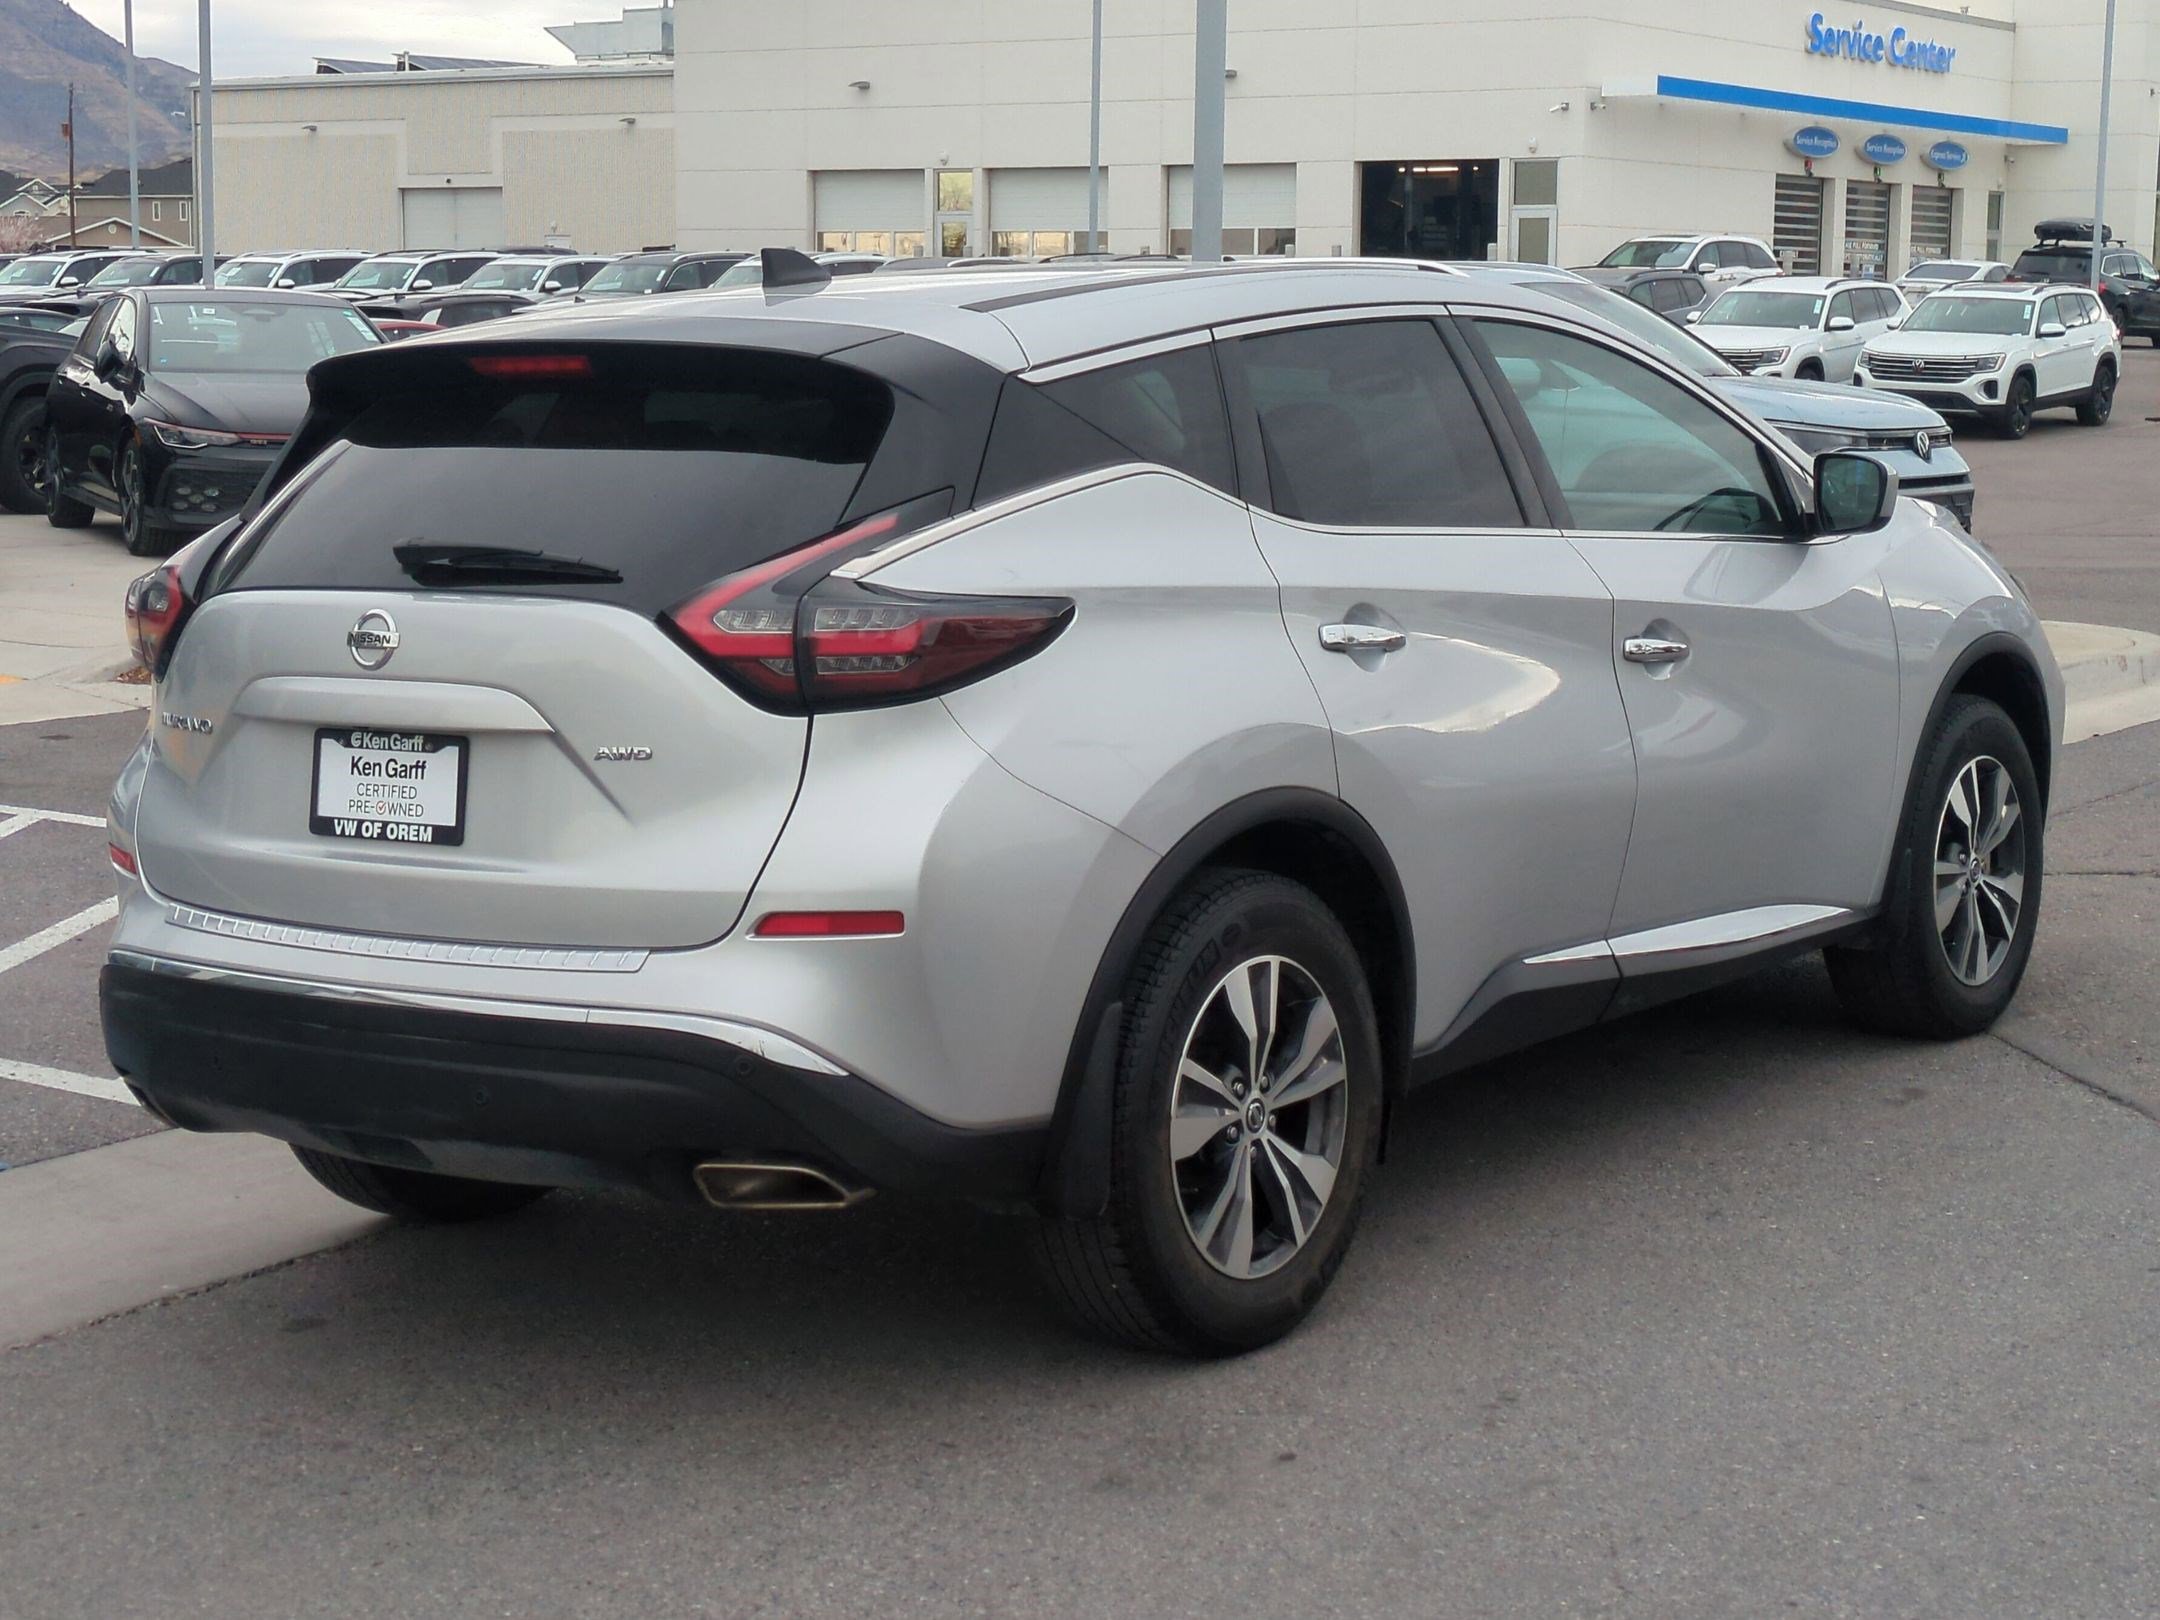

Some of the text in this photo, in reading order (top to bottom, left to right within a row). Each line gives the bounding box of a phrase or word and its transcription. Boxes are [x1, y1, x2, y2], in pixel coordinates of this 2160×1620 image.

[1807, 12, 1956, 73] Service Center
[349, 633, 391, 645] NISSAN
[363, 732, 388, 749] Ken
[390, 734, 424, 751] Garff
[594, 746, 652, 761] AWD
[350, 755, 427, 780] Ken Garff
[356, 783, 417, 799] CERTIFIED
[334, 818, 432, 842] VW OF OREM
